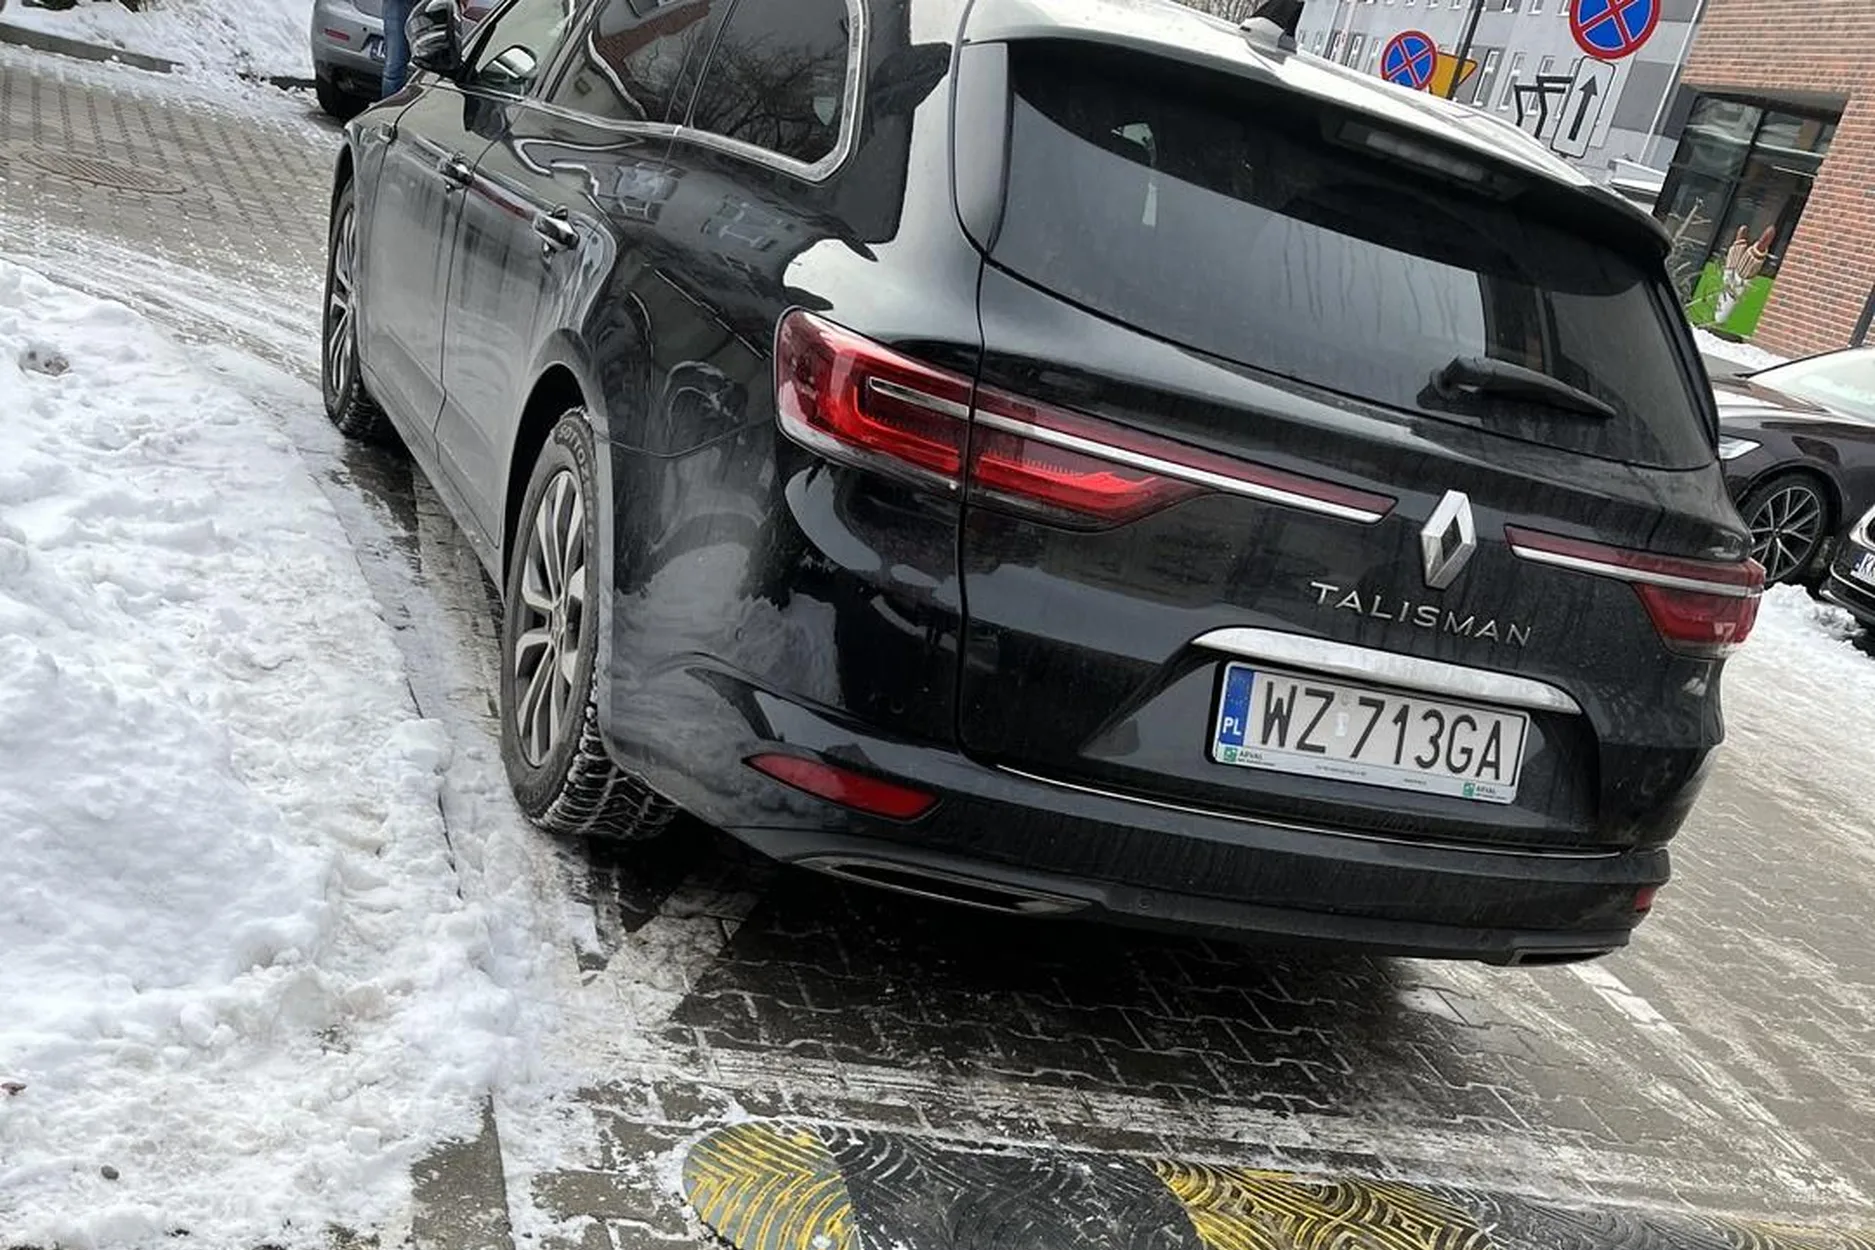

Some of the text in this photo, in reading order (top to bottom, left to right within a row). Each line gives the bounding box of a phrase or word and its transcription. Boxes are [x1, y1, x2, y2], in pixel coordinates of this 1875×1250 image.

[1310, 581, 1531, 646] TALISMAN
[1222, 716, 1242, 736] PL
[1262, 681, 1501, 780] WZ 713GA
